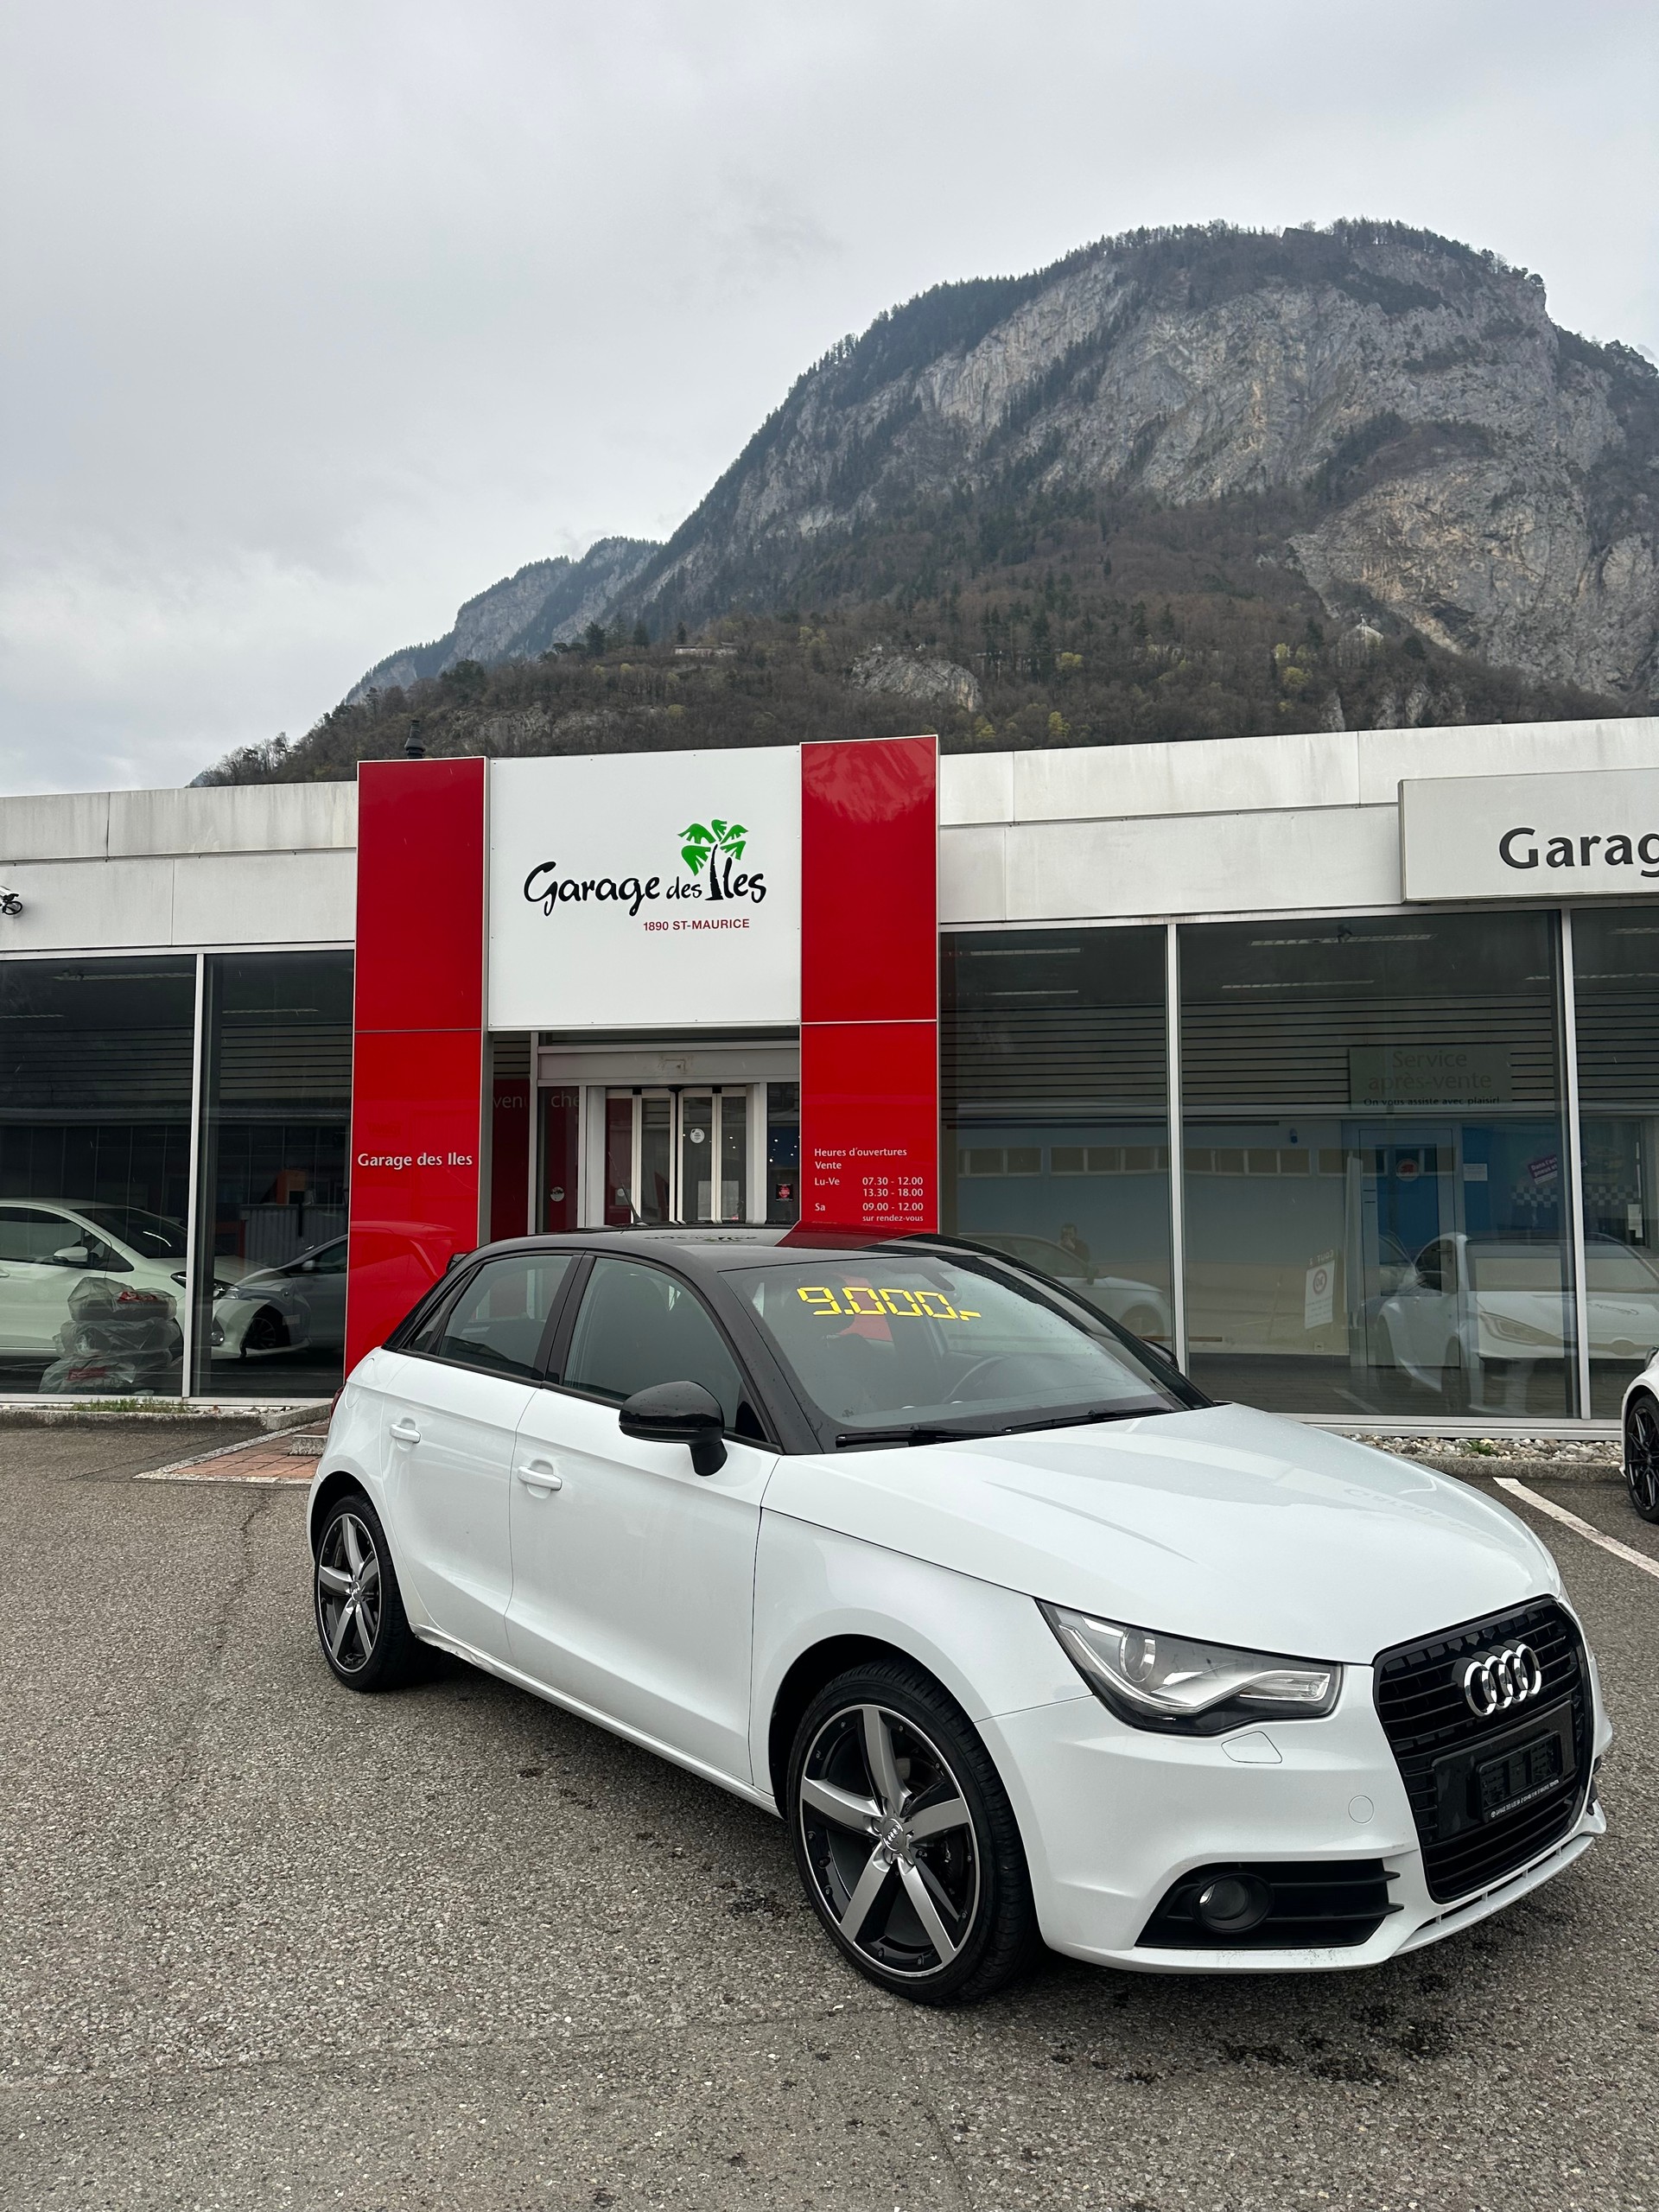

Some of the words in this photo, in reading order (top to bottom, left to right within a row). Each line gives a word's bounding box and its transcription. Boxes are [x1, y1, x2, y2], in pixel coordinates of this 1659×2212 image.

[1498, 827, 1659, 878] Garag
[524, 861, 660, 917] Garage
[665, 875, 702, 899] des
[704, 843, 767, 904] Iles
[643, 921, 670, 931] 1890
[672, 918, 750, 931] ST-MAURICE
[1392, 1050, 1467, 1068] Service
[1368, 1071, 1492, 1095] après-vente
[1467, 1096, 1500, 1105] plaisir!
[814, 1147, 846, 1157] Heures
[849, 1147, 907, 1156] d'ouvertures
[358, 1153, 412, 1171] Garage
[416, 1152, 442, 1166] des
[448, 1152, 473, 1166] Iles
[815, 1160, 842, 1170] Vente
[814, 1177, 840, 1185] Lu-Ve
[862, 1177, 888, 1185] 07.30
[898, 1177, 924, 1185] 12.00
[862, 1188, 888, 1197] 13.30
[898, 1188, 924, 1197] 18.00
[815, 1203, 826, 1211] Sa
[862, 1202, 888, 1211] 09.00
[898, 1202, 924, 1211] 12.00
